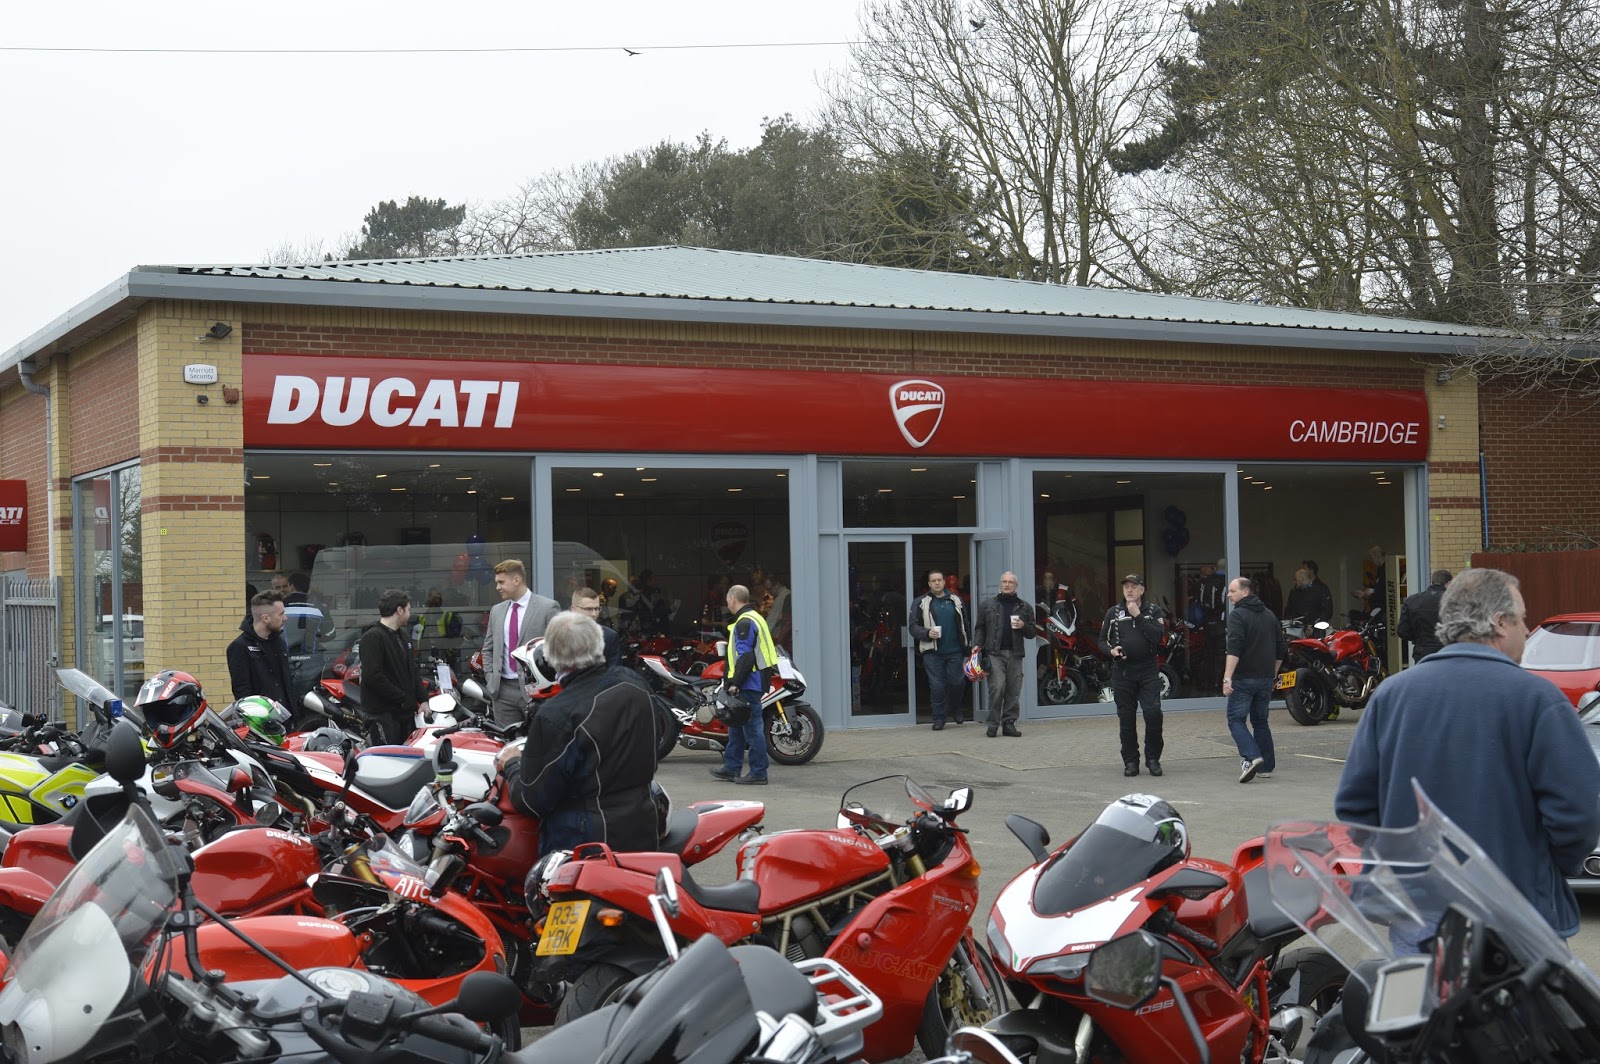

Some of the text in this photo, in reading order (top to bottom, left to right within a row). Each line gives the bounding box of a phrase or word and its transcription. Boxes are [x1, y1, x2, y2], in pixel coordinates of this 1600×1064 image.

[267, 375, 520, 428] DUCATI
[899, 390, 942, 402] DUCATI
[1289, 419, 1420, 445] CAMBRIDGE
[265, 830, 302, 846] DUCATI
[829, 834, 874, 851] DUCATI
[297, 921, 341, 931] DUCATI
[1070, 943, 1096, 952] DUCATI
[1135, 998, 1175, 1017] 1098
